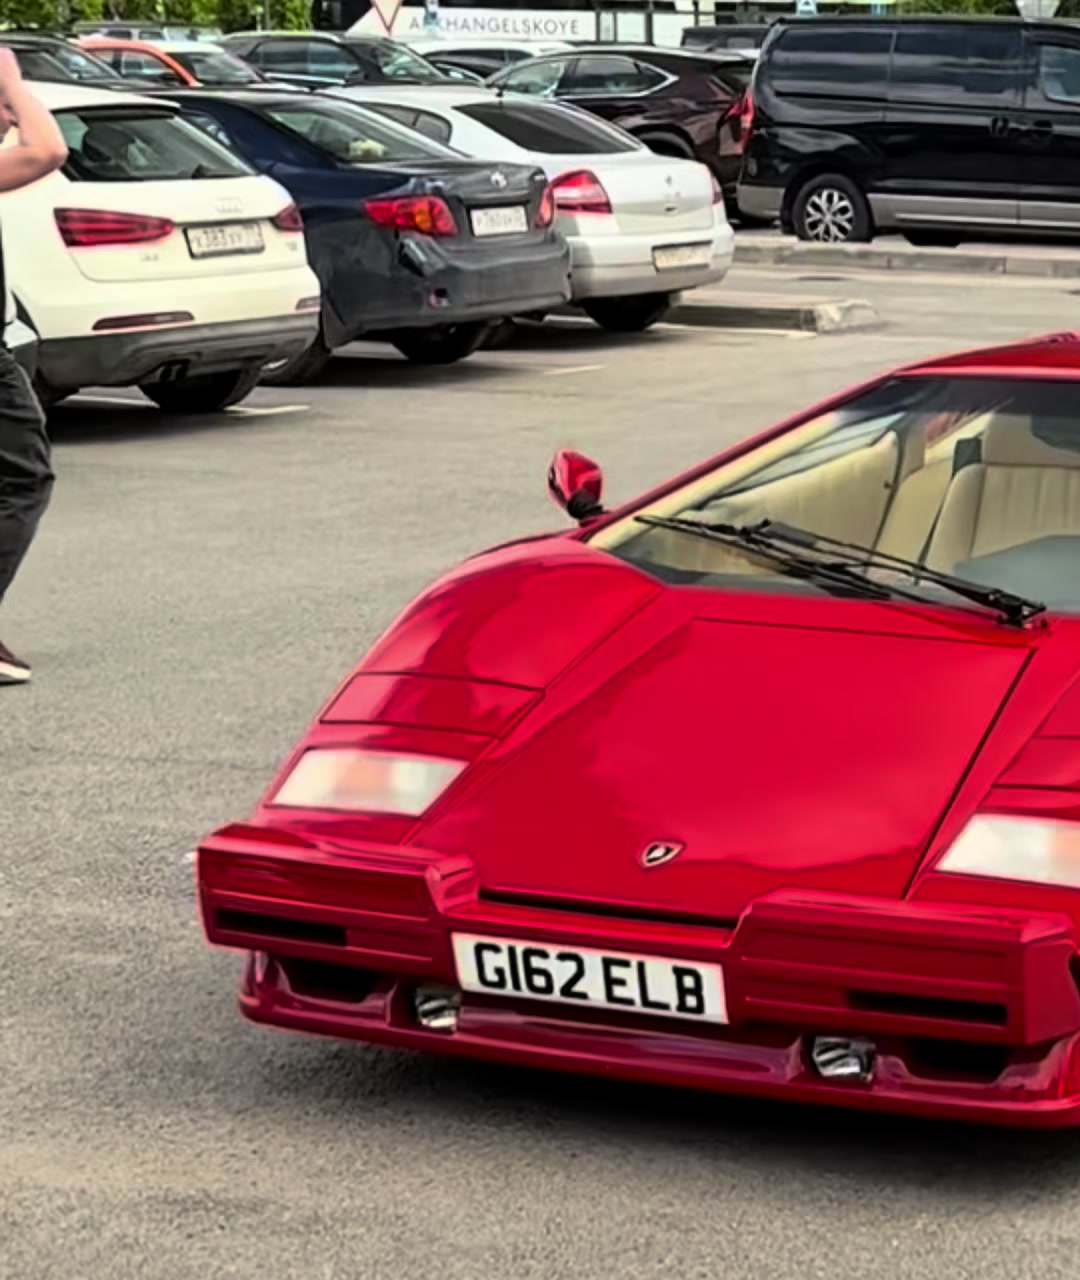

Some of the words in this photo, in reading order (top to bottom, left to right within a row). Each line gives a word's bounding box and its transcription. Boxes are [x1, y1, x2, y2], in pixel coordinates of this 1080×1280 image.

[409, 16, 579, 35] AKHANGELSKOYE
[474, 941, 590, 1001] G162
[600, 956, 705, 1015] ELB
